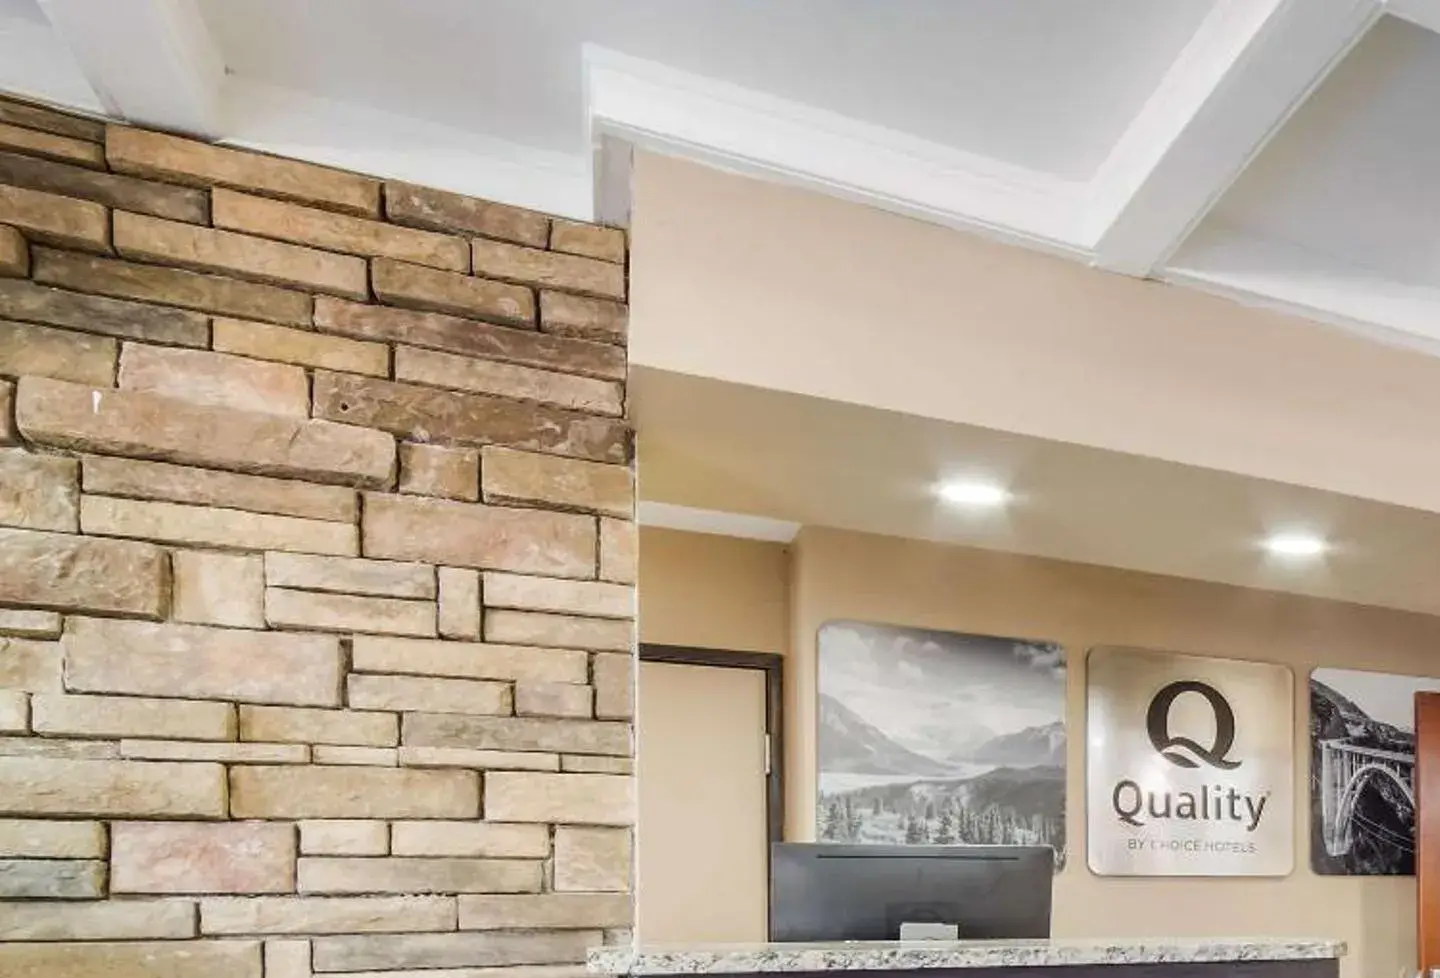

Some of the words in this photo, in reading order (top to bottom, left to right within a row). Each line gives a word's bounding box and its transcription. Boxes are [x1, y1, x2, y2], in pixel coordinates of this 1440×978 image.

[1146, 680, 1243, 771] Q
[1112, 779, 1267, 833] Quality
[1127, 838, 1145, 850] BY
